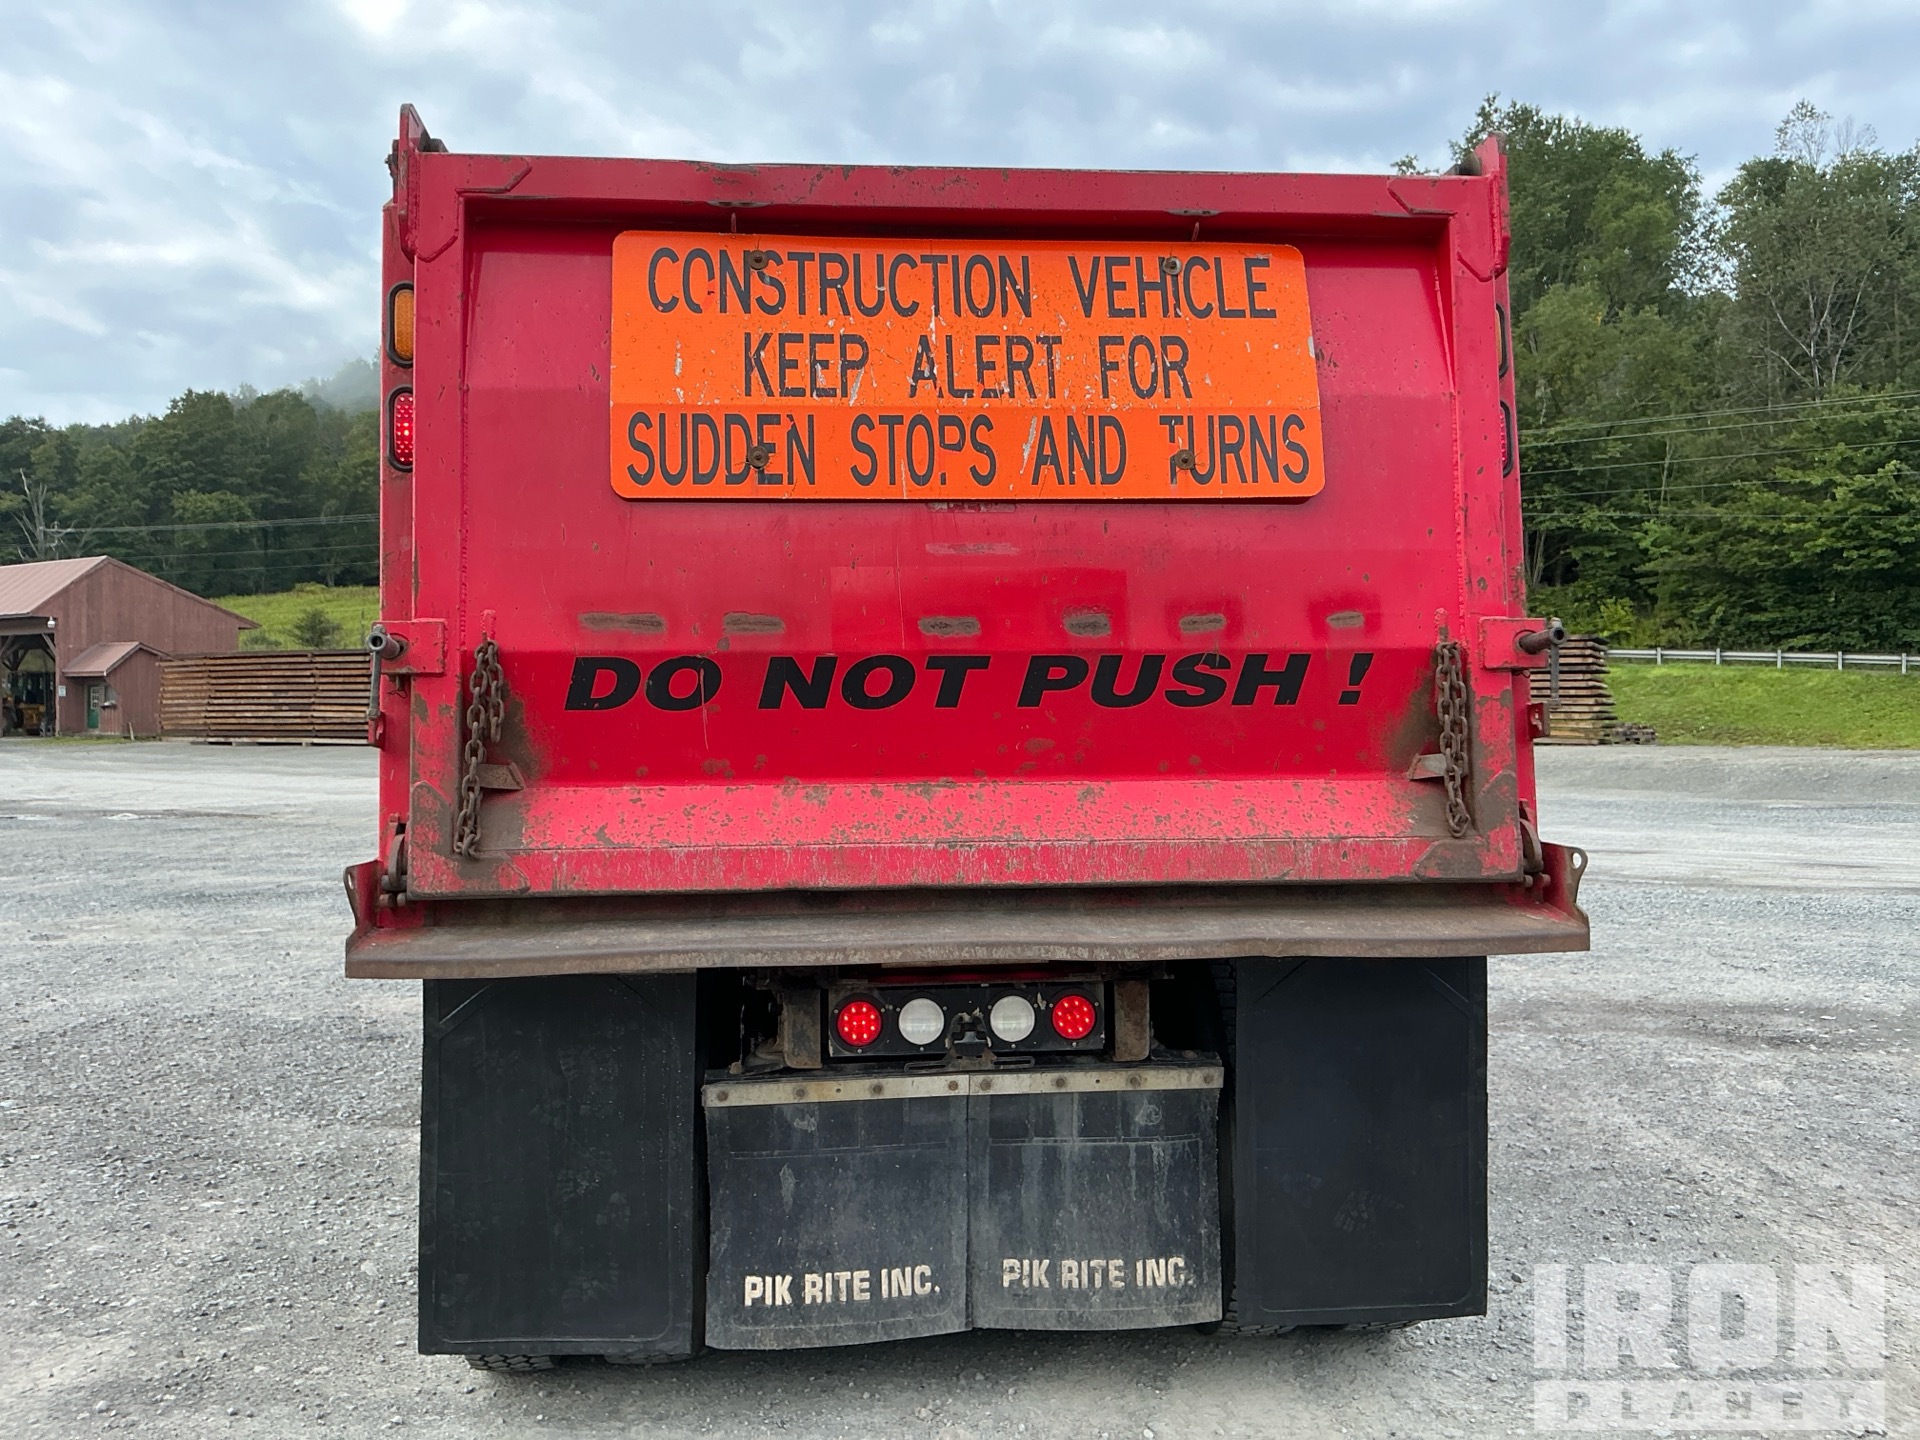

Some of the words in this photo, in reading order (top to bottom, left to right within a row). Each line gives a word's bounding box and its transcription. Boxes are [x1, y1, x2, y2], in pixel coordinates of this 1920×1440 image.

[647, 247, 1032, 318] CONSTRUCTION
[1071, 256, 1277, 319] VEHICLE
[744, 332, 869, 398] KEEP
[909, 334, 1080, 399] ALERT
[1101, 335, 1193, 399] FOR
[627, 411, 815, 487] SUDDEN
[850, 413, 997, 487] STOPS
[1031, 415, 1125, 486] AND
[1159, 414, 1310, 486] TURNS
[565, 655, 723, 712] DO
[757, 654, 991, 710] NOT
[1016, 653, 1311, 709] PUSH
[1337, 652, 1375, 706] !
[744, 1275, 793, 1307] PIK
[804, 1270, 871, 1304] RITE
[881, 1264, 941, 1299] INC.
[1002, 1258, 1051, 1289] PIK
[1061, 1258, 1125, 1289] RITE
[1135, 1256, 1194, 1288] INC.
